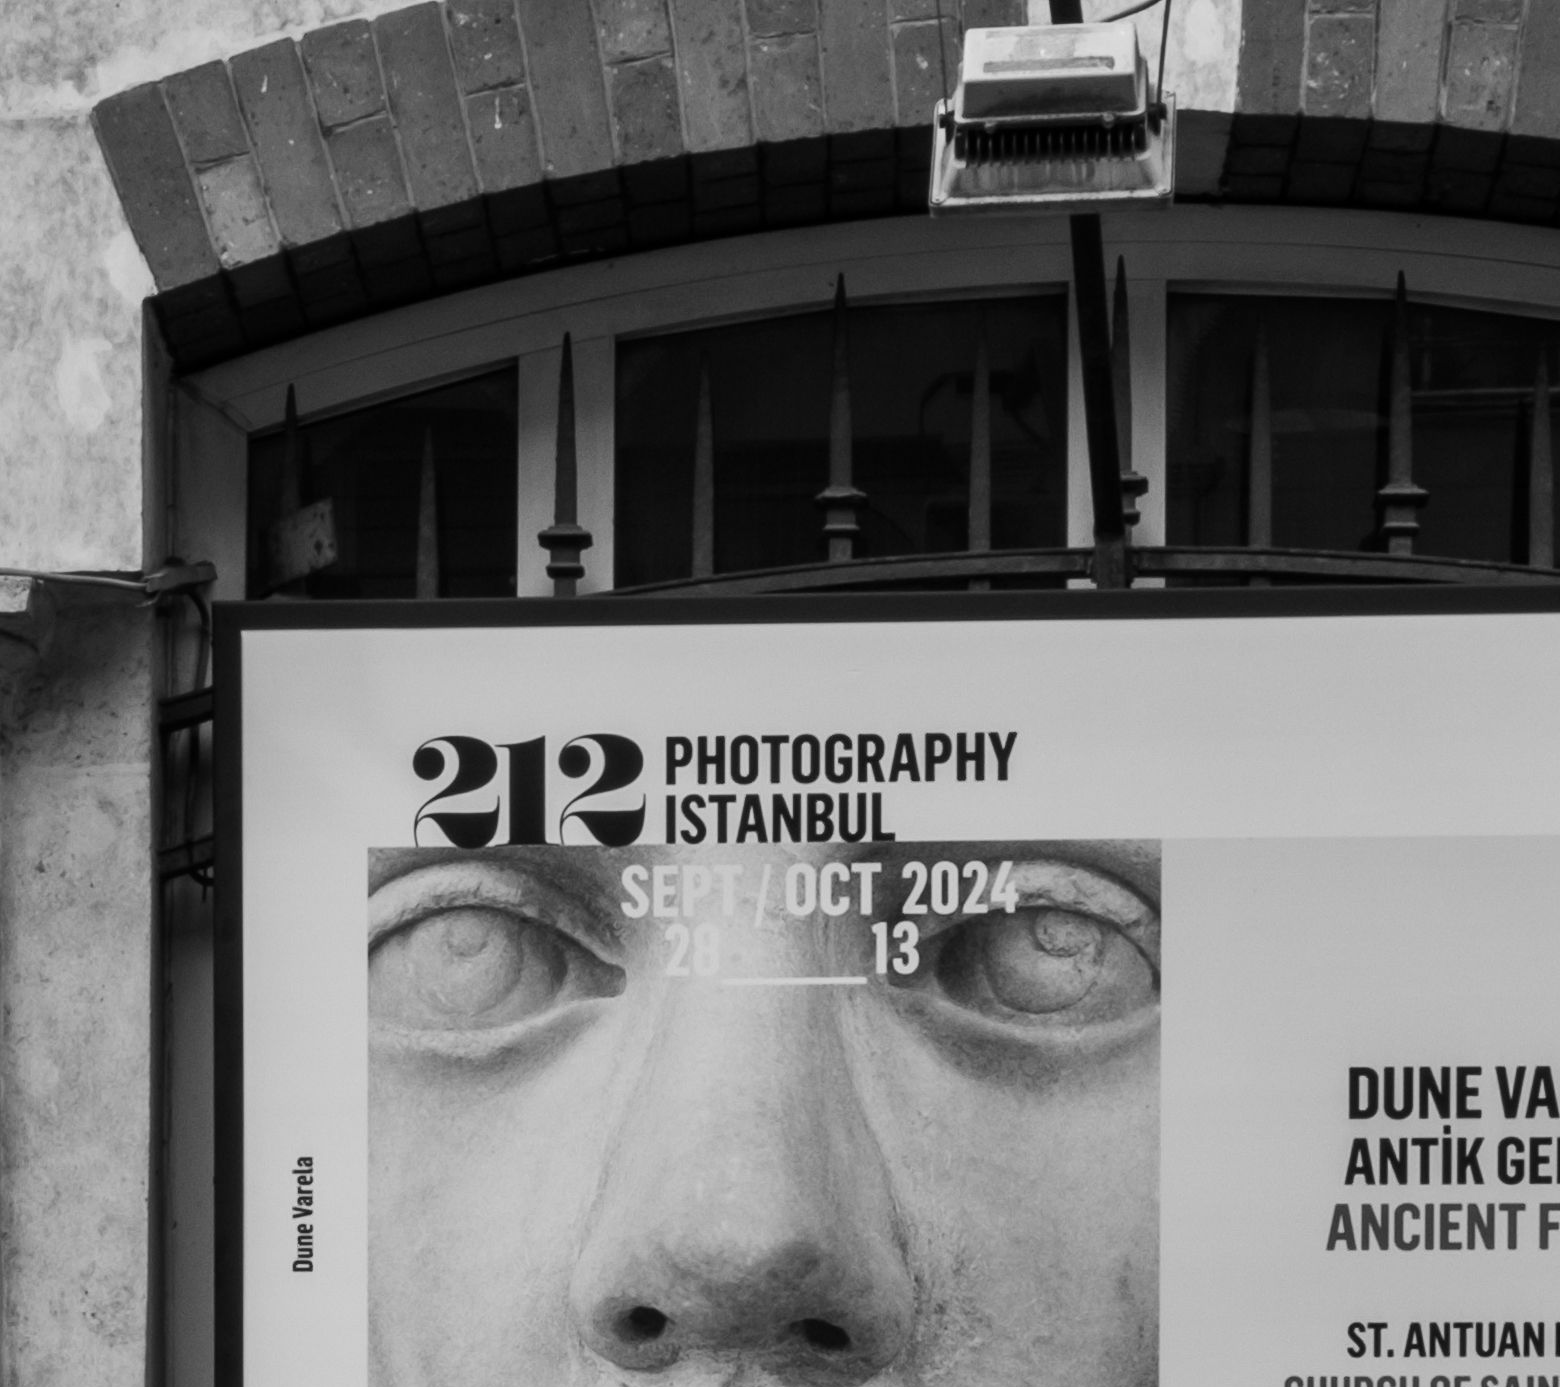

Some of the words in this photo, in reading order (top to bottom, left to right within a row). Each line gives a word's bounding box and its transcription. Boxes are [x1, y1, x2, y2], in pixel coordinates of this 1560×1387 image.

[412, 733, 646, 849] 212
[666, 732, 1017, 785] PHOTOGRAPHY
[665, 793, 896, 845] ISTANBUL
[620, 864, 743, 918] SEPT
[786, 861, 883, 916] OCT
[902, 860, 1018, 915] 2024
[1349, 1067, 1482, 1120] DUNE
[1345, 1125, 1484, 1185] ANTİK
[292, 1157, 313, 1218] Varela
[293, 1224, 313, 1272] Dune
[1326, 1203, 1526, 1251] ANCIENT
[1348, 1322, 1394, 1358] ST.
[1404, 1322, 1544, 1357] ANTUAN
